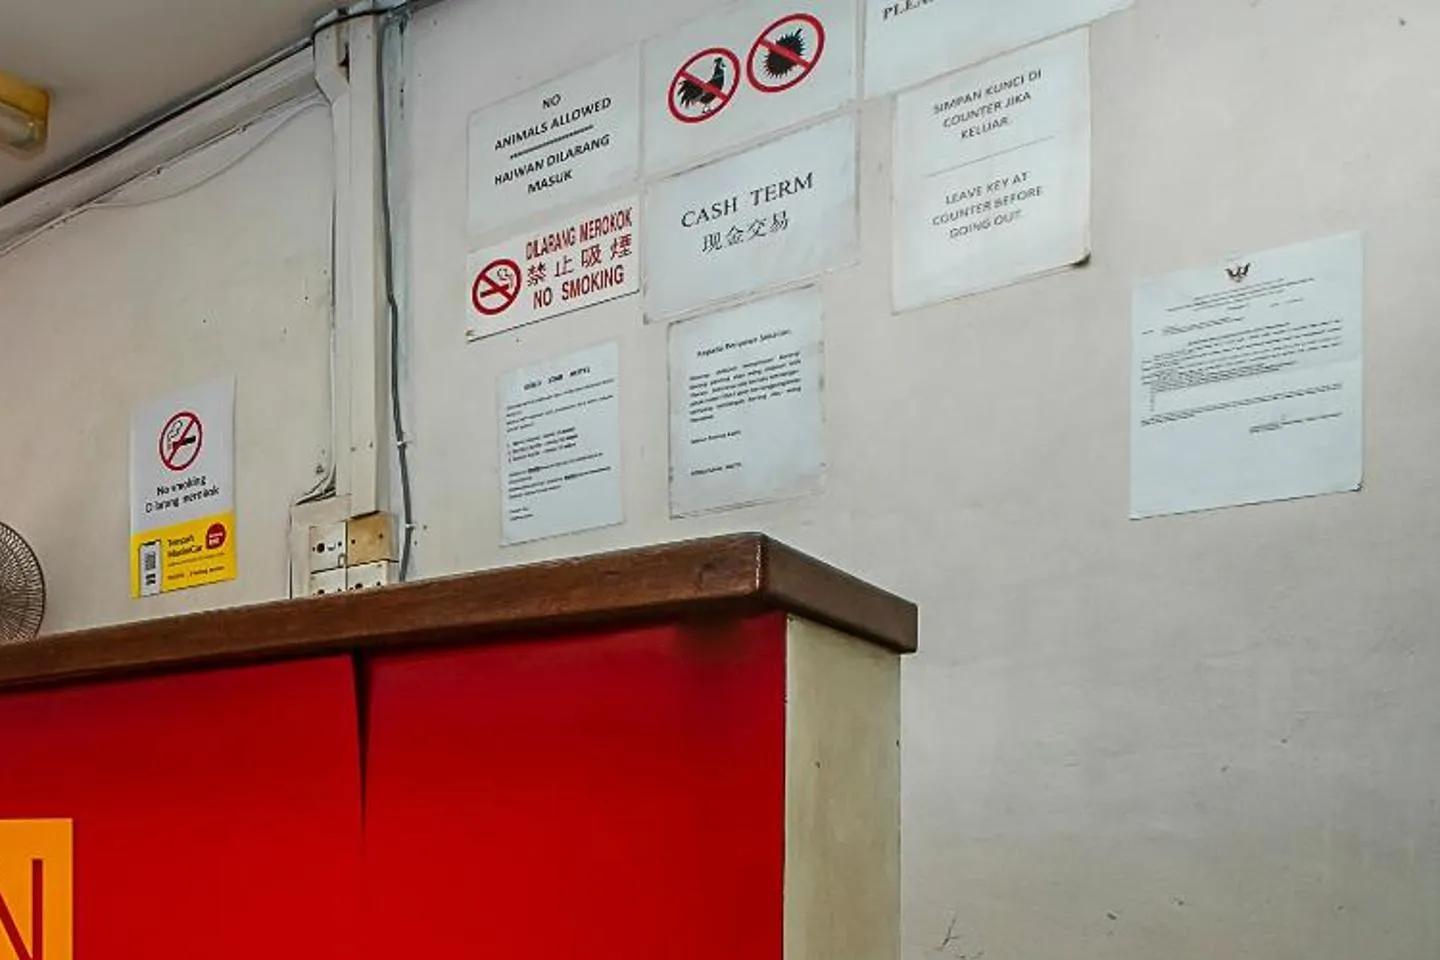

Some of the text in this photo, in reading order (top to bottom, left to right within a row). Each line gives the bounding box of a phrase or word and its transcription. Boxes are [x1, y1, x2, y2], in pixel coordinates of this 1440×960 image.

[542, 94, 561, 109] NO
[934, 68, 1042, 115] SIMPAN KUNCI DI
[943, 91, 1031, 127] COUNTER JIKA
[495, 97, 612, 150] ANIMALS ALLOWED
[494, 134, 610, 185] HAIWAN DILARANG
[527, 169, 573, 194] MASUK
[681, 172, 813, 228] CASH TERM
[946, 170, 1030, 205] LEAVE KEY AT
[932, 185, 1042, 226] COUNTER BEFORE
[526, 207, 633, 261] DILARANG MEROKOK
[701, 210, 789, 254] 现金交易
[950, 219, 991, 239] GOING
[533, 264, 625, 310] NO SMOKING
[156, 486, 170, 497] No
